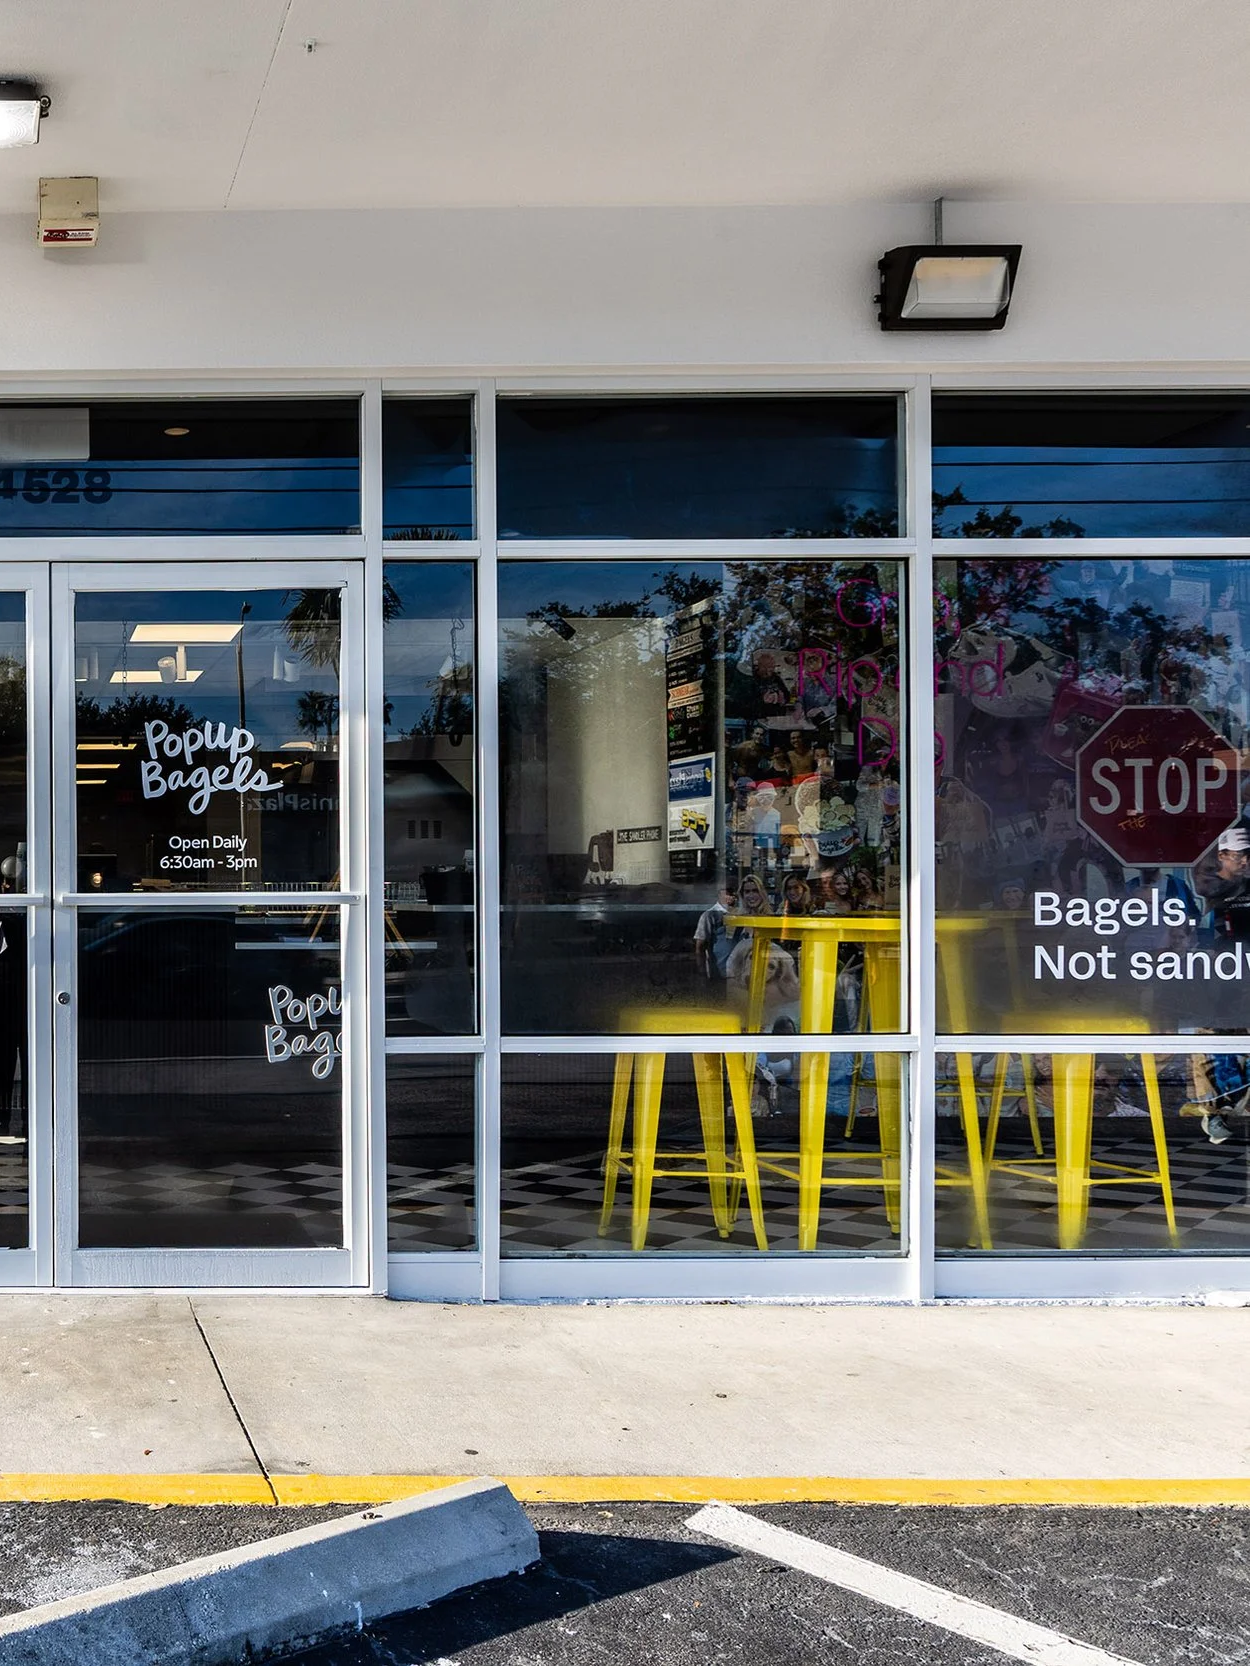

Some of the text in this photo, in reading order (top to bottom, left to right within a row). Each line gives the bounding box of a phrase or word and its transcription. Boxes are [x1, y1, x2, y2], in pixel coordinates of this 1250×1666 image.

[798, 641, 883, 711] Rip
[893, 640, 1005, 698] nd
[144, 719, 254, 766] PopUp
[140, 756, 283, 815] Bagels
[1089, 757, 1228, 816] STOP
[160, 856, 214, 869] 6:30am
[226, 855, 257, 871] 3pm
[169, 835, 247, 851] Open Daily
[1034, 888, 1196, 935] Bagels.
[1034, 944, 1117, 981] Not
[269, 985, 342, 1031] PopU
[265, 1025, 342, 1080] Bag
